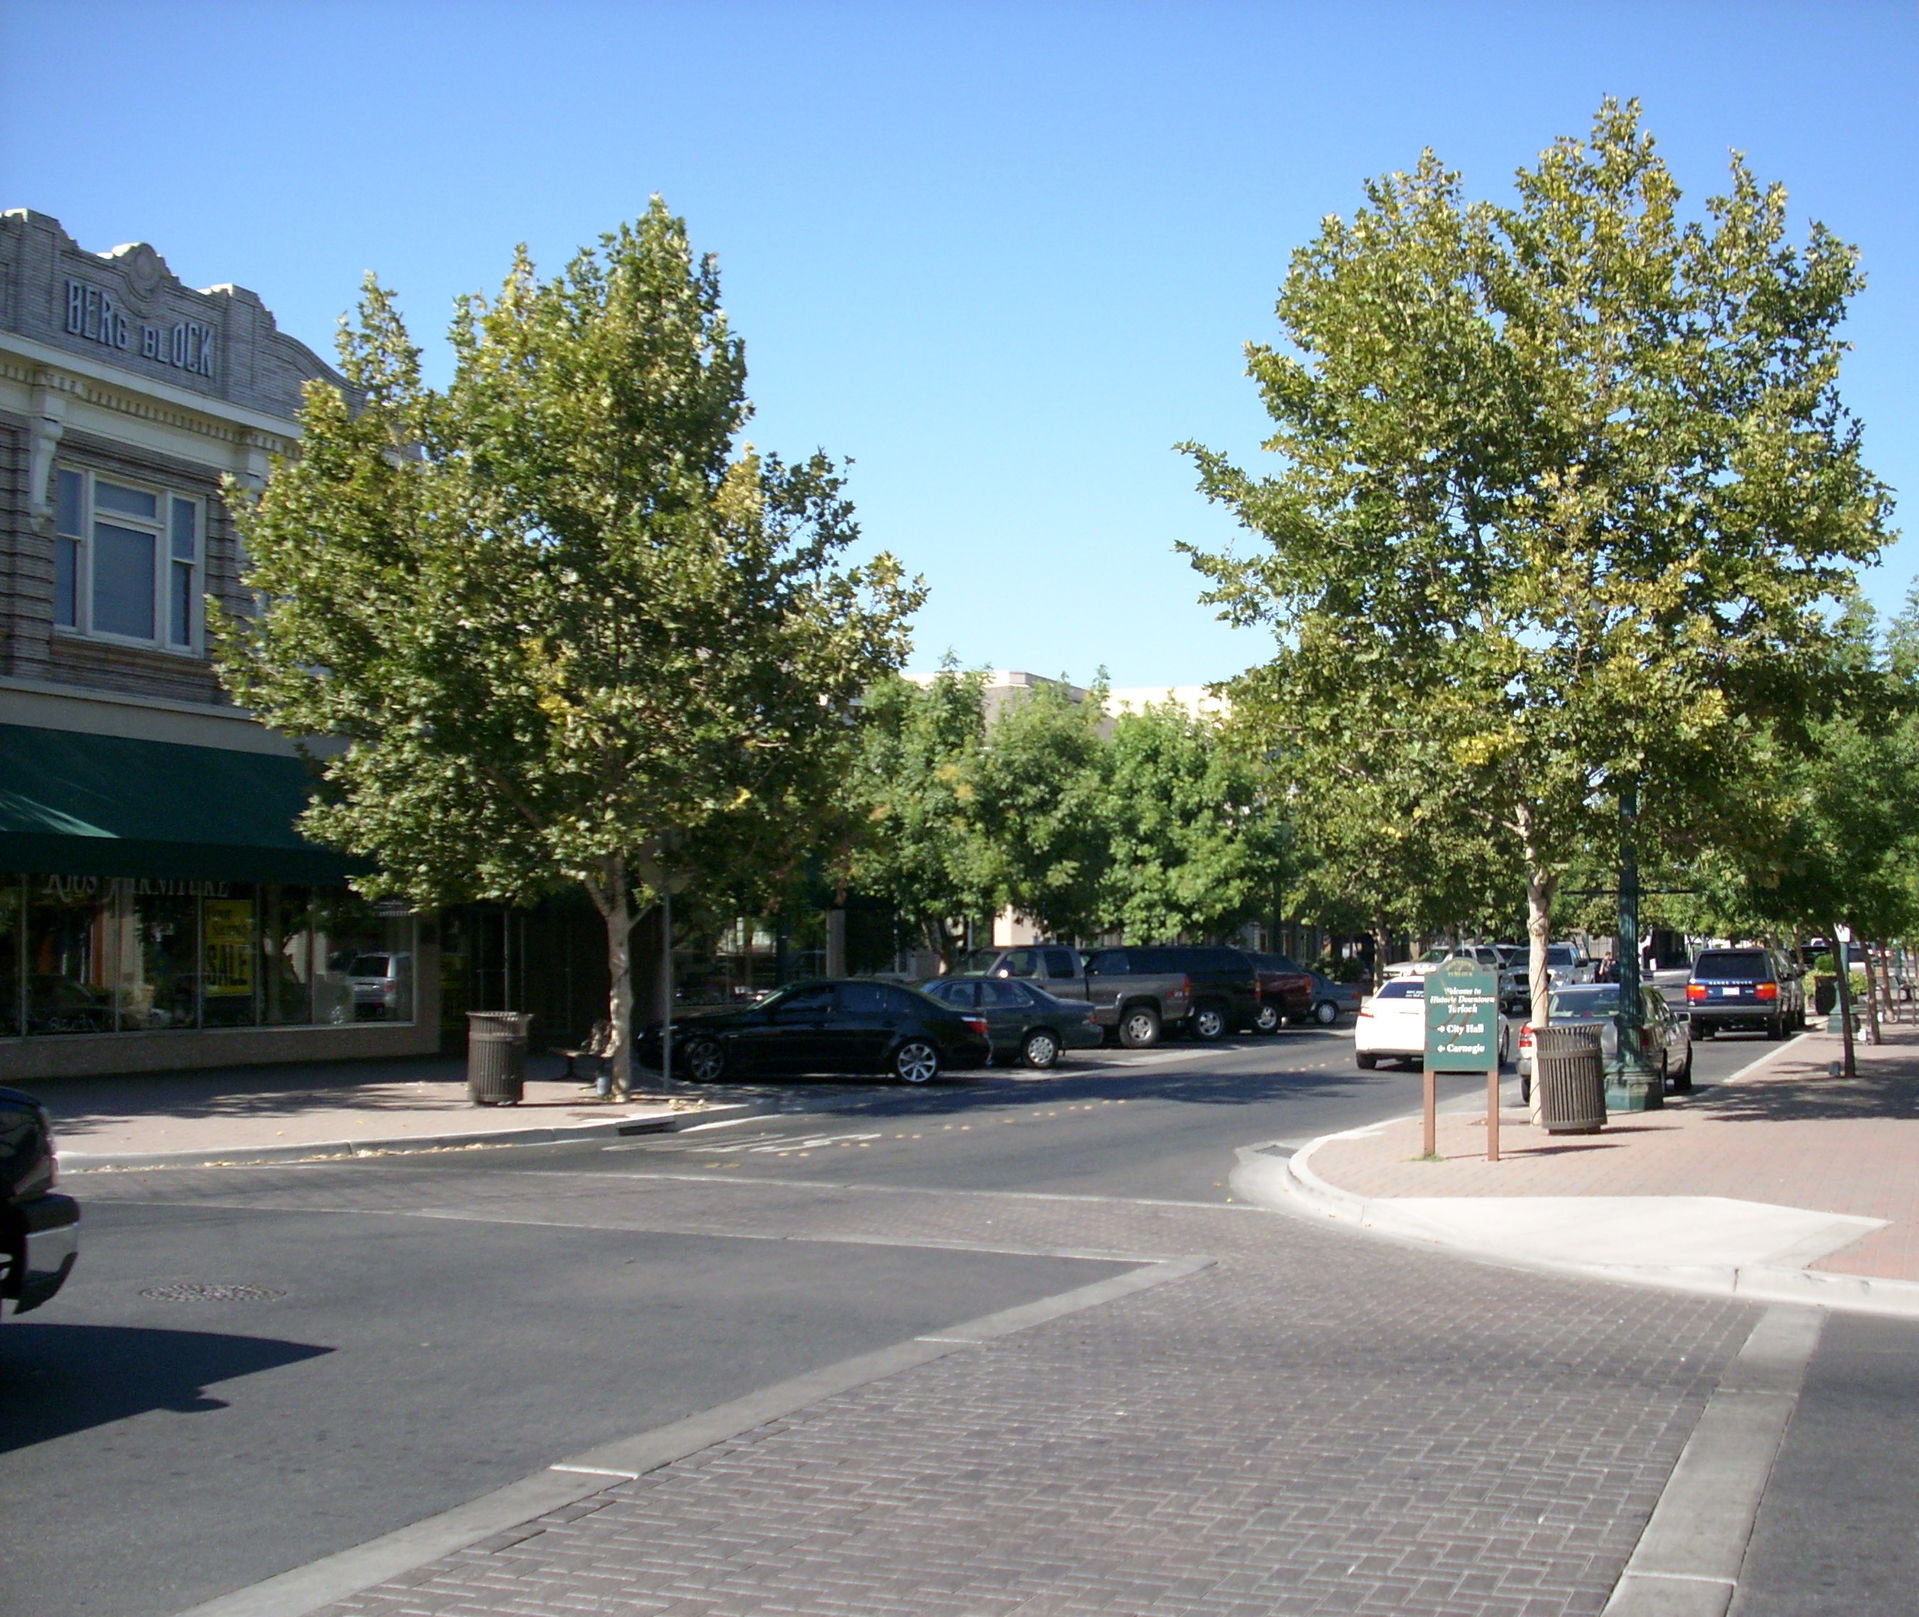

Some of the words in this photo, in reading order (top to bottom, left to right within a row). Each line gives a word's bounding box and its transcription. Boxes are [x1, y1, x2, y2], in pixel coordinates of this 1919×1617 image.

[66, 280, 129, 350] BERG
[142, 321, 213, 377] BLOCK
[1444, 987, 1473, 995] Welcome
[1448, 1004, 1478, 1013] Turlock
[1446, 1025, 1464, 1035] City
[1466, 1024, 1484, 1033] Hall
[1446, 1044, 1485, 1054] Carnegie
